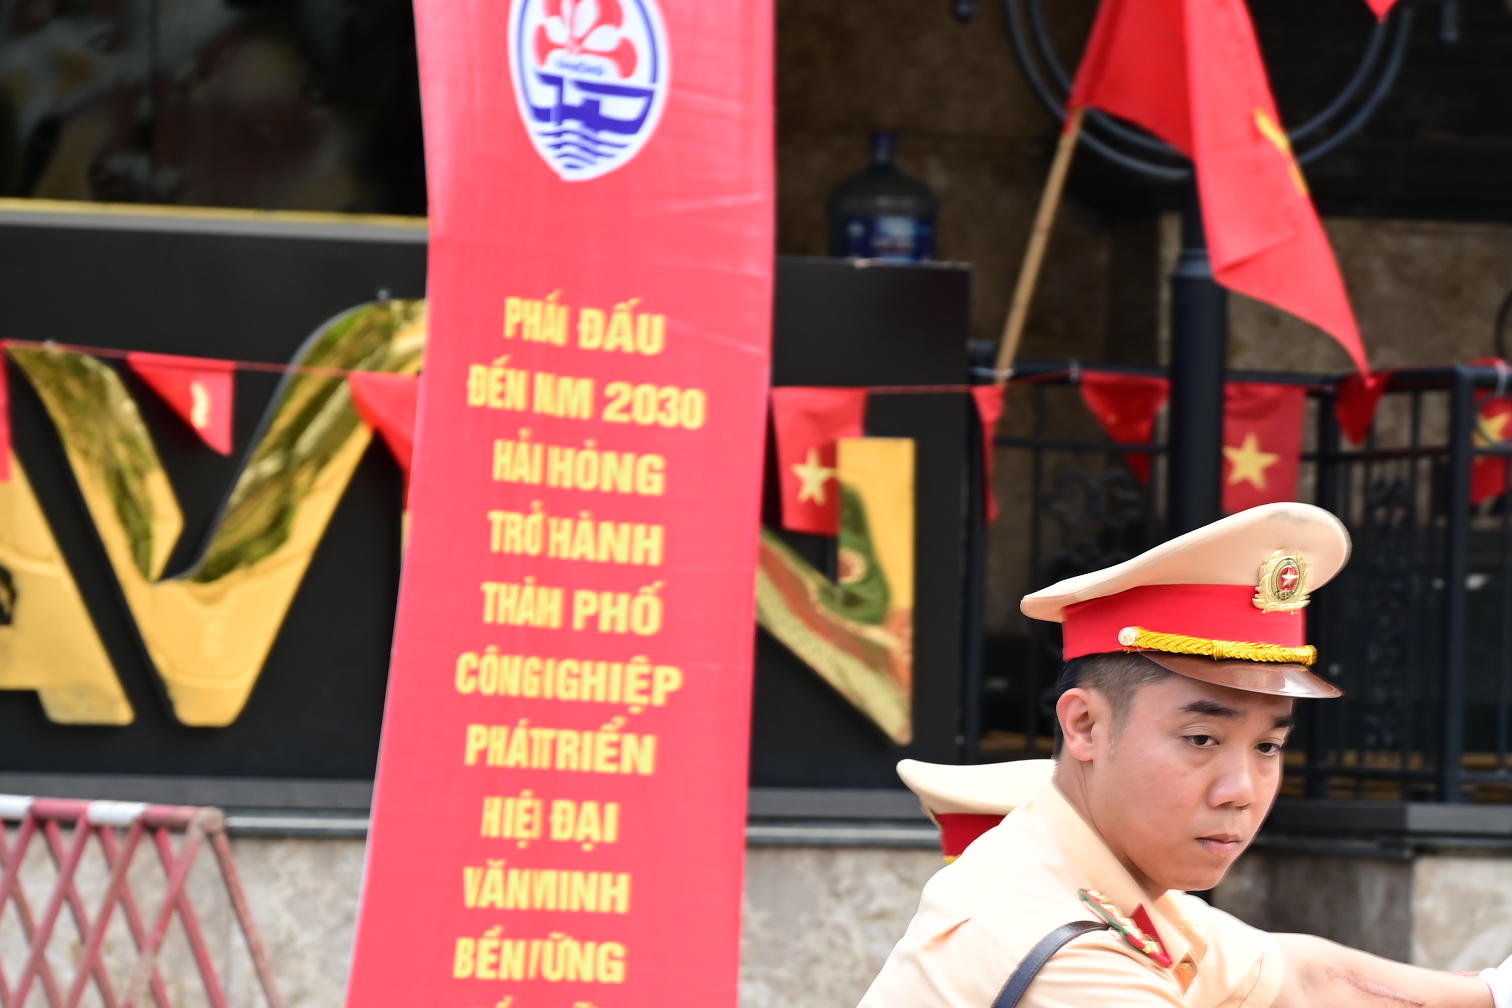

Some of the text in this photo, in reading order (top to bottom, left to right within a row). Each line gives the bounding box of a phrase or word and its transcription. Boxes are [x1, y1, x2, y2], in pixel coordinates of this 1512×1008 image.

[577, 297, 667, 355] ĐẤU
[466, 354, 529, 411] ĐẾN
[602, 382, 707, 430] 2030
[492, 427, 666, 496] HẢI HÒNG
[488, 500, 664, 566] TRỞ HÀNH
[572, 580, 666, 636] PHỐ
[455, 644, 541, 700] CÔNG
[540, 715, 656, 776] TRIỂN
[480, 789, 620, 852] HIỆ ĐẠI
[463, 858, 531, 911] VĂN
